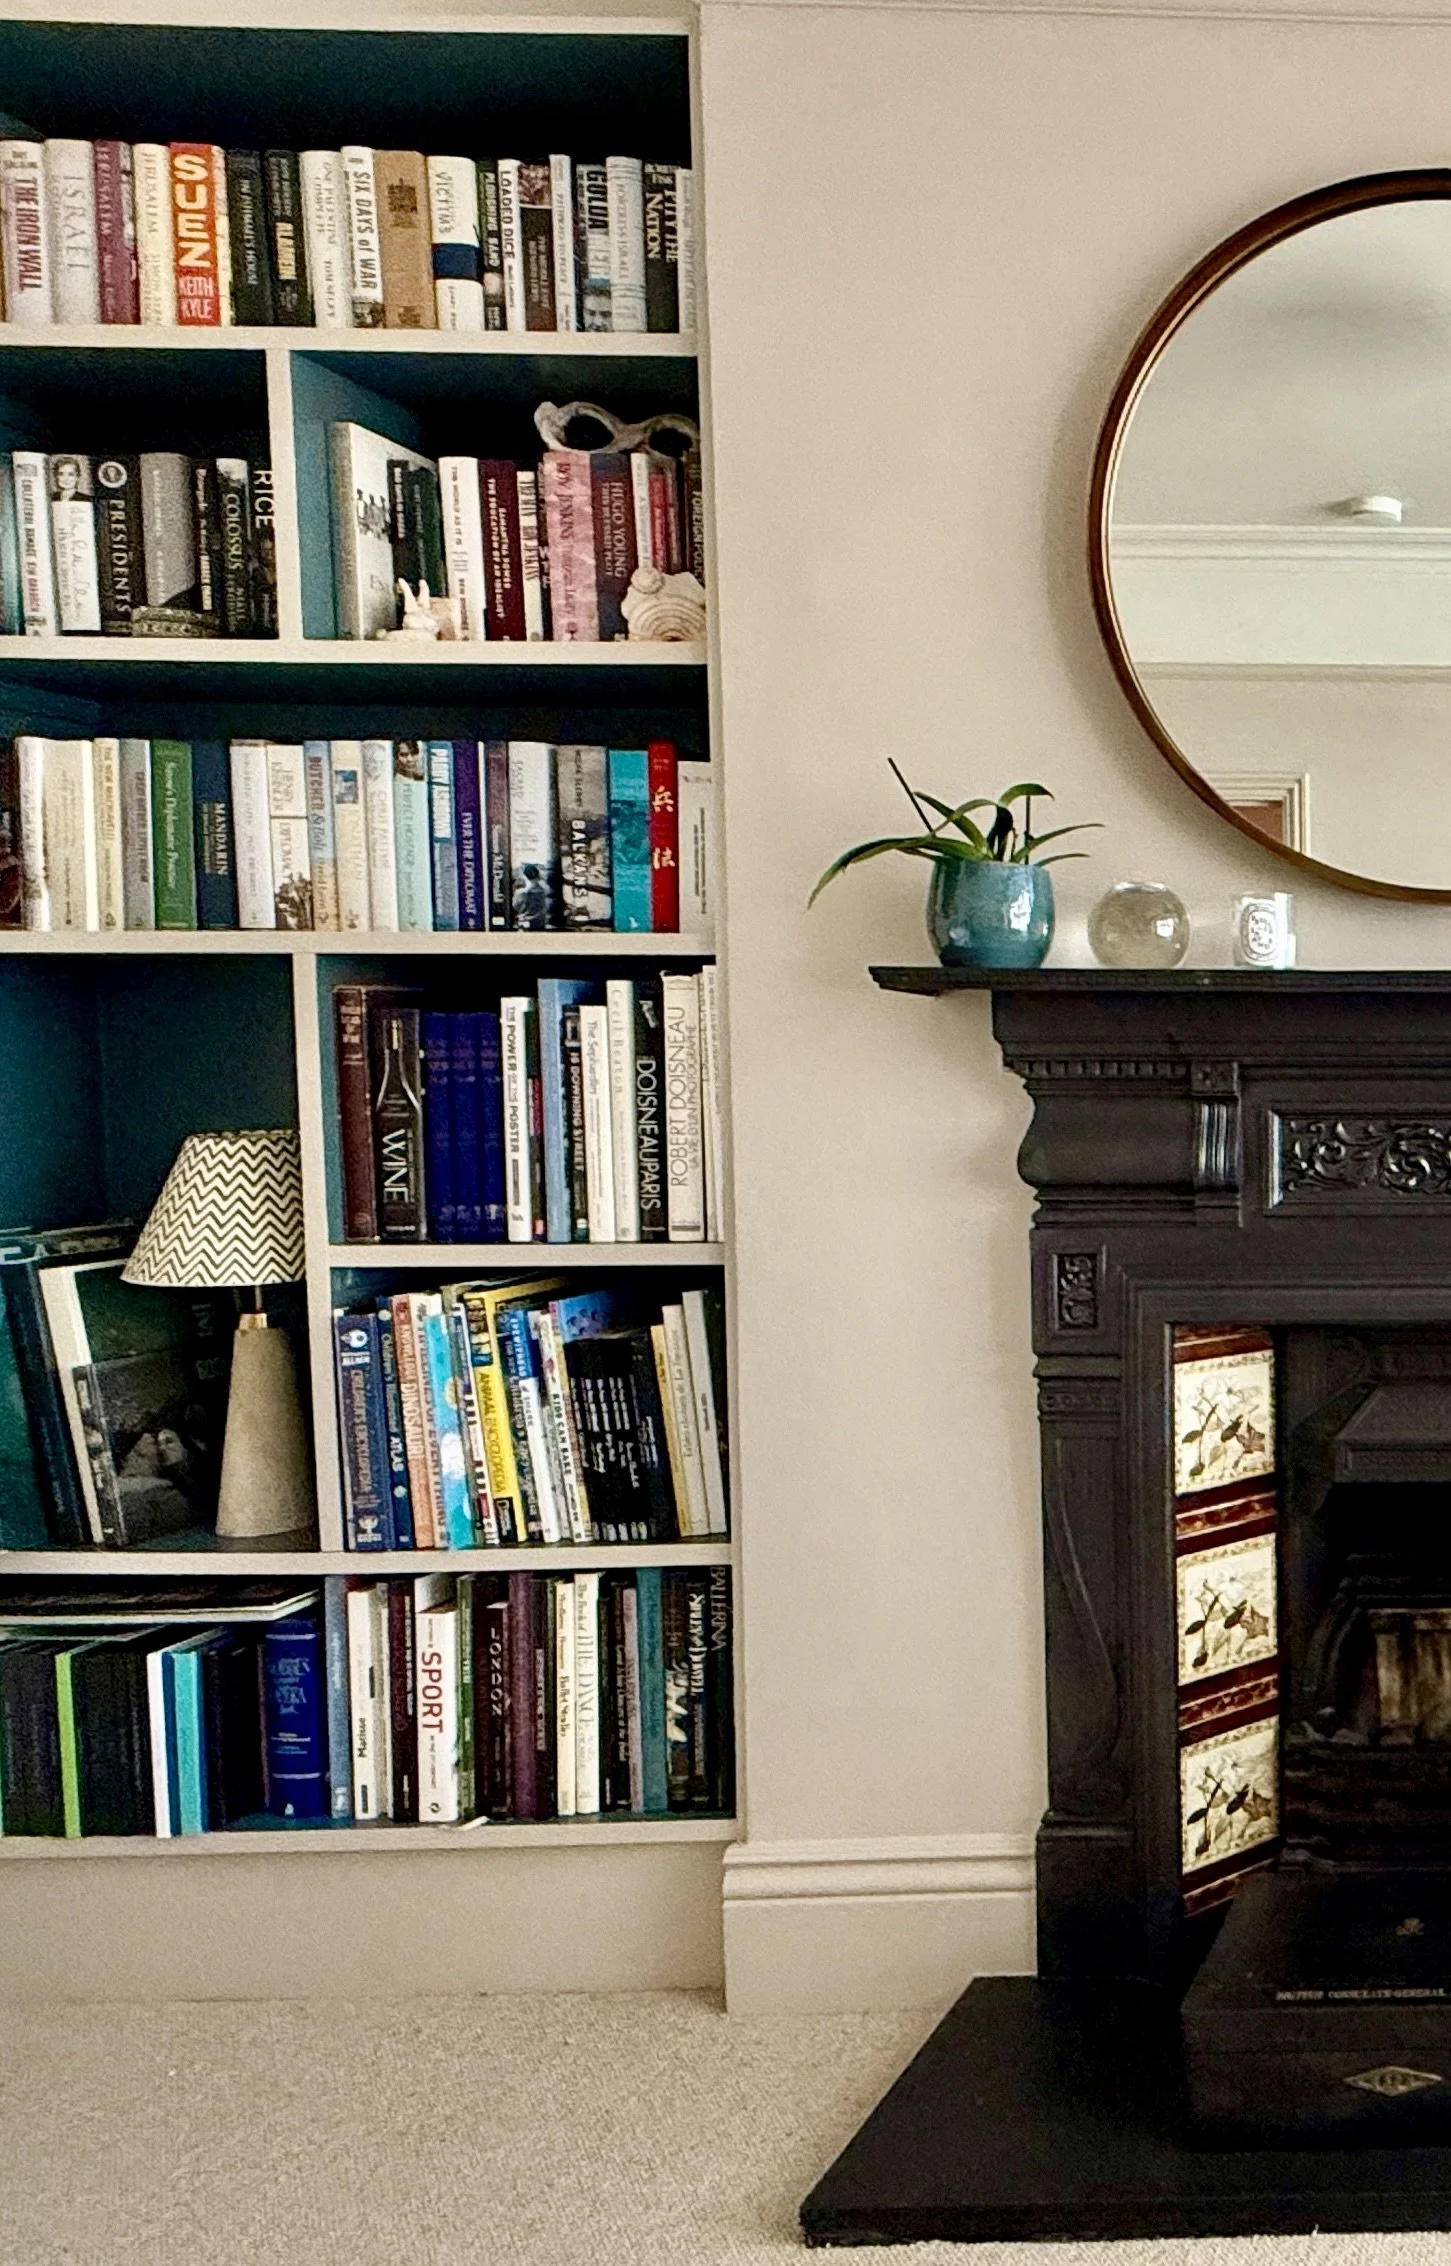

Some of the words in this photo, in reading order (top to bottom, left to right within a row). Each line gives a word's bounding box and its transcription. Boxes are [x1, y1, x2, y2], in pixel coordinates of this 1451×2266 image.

[16, 178, 40, 206] THE
[97, 147, 111, 235] JERUSALEM
[142, 154, 158, 232] JERUSALEM
[353, 171, 371, 192] SIX
[435, 172, 452, 234] VICTIMS
[485, 172, 498, 231] PLOUGHING
[500, 170, 513, 224] LOADED
[586, 171, 608, 229] GOLDA
[17, 208, 40, 246] IRON
[63, 176, 89, 274] ISRAEL
[174, 153, 212, 268] SUEZ
[356, 200, 374, 234] DAYS
[664, 190, 677, 231] PITY
[359, 240, 375, 252] of
[488, 238, 500, 266] SAND
[504, 228, 515, 258] DICE
[666, 233, 678, 263] THE
[18, 249, 42, 291] WALL
[178, 275, 215, 296] KEITH
[246, 250, 258, 285] HOUSE
[360, 258, 377, 289] WAR
[179, 299, 213, 319] KYLE
[451, 466, 459, 481] THE
[487, 478, 495, 495] THE
[556, 463, 571, 489] ROY
[601, 483, 610, 504] THIS
[22, 480, 36, 524] COLLATERAL
[253, 470, 275, 528] RICE
[452, 485, 460, 512] WORLD
[454, 516, 461, 525] AS
[556, 494, 574, 540] JENKINS
[610, 482, 626, 524] HUGO
[692, 491, 704, 542] FOREIGN
[26, 528, 36, 557] DAMAGE
[224, 493, 242, 570] COLOSSUS
[488, 497, 498, 548] EDUCATION
[499, 508, 509, 555] SAMANTHA
[110, 500, 131, 612] PRESIDENTS
[492, 551, 499, 562] OF
[493, 565, 501, 577] AN
[502, 558, 511, 588] POWER
[523, 543, 539, 581] JENKINS
[604, 552, 613, 576] PLOT
[614, 528, 627, 577] YOUNG
[494, 579, 503, 619] IDEALIST
[309, 756, 324, 810] BUTCHER
[214, 802, 228, 875] MANDARIN
[311, 813, 326, 824] &
[460, 812, 472, 838] EVER
[279, 822, 293, 884] DIPLOMACY
[462, 840, 474, 859] THE
[571, 819, 588, 897] BALKANS
[462, 861, 476, 915] DIPLOMAT
[492, 854, 504, 903] McDonald
[586, 1020, 598, 1040] The
[611, 989, 624, 1032] Cecil
[506, 1024, 517, 1071] POWER
[612, 1039, 625, 1094] Beaton
[667, 1007, 686, 1109] DOISNEAU
[571, 1066, 583, 1128] DOWNING
[509, 1105, 520, 1153] POSTER
[573, 1129, 585, 1172] STREET
[382, 1129, 409, 1203] WINE
[669, 1117, 688, 1187] ROBERT
[510, 1318, 527, 1377] EYEWITNESS
[350, 1370, 367, 1423] CHILDREN'S
[381, 1333, 394, 1382] Children's
[390, 1435, 404, 1472] ATLAS
[478, 1372, 497, 1416] ANIMAL
[510, 1376, 527, 1437] Children's
[552, 1393, 563, 1418] KIDS
[485, 1418, 506, 1493] ENCYCLOPEDIA
[556, 1422, 567, 1445] CAN
[353, 1425, 372, 1493] ENCYCLOPEDIA
[430, 1430, 445, 1527] EVERYTHING
[515, 1439, 537, 1516] Encyclopedia
[558, 1447, 571, 1476] BAKE
[577, 1584, 589, 1600] The
[710, 1567, 727, 1651] BALLERINA
[489, 1628, 502, 1716] LONDON
[577, 1635, 595, 1667] THE
[421, 1651, 444, 1734] SPORT
[578, 1673, 595, 1727] DANCE
[357, 1717, 368, 1758] Matisse
